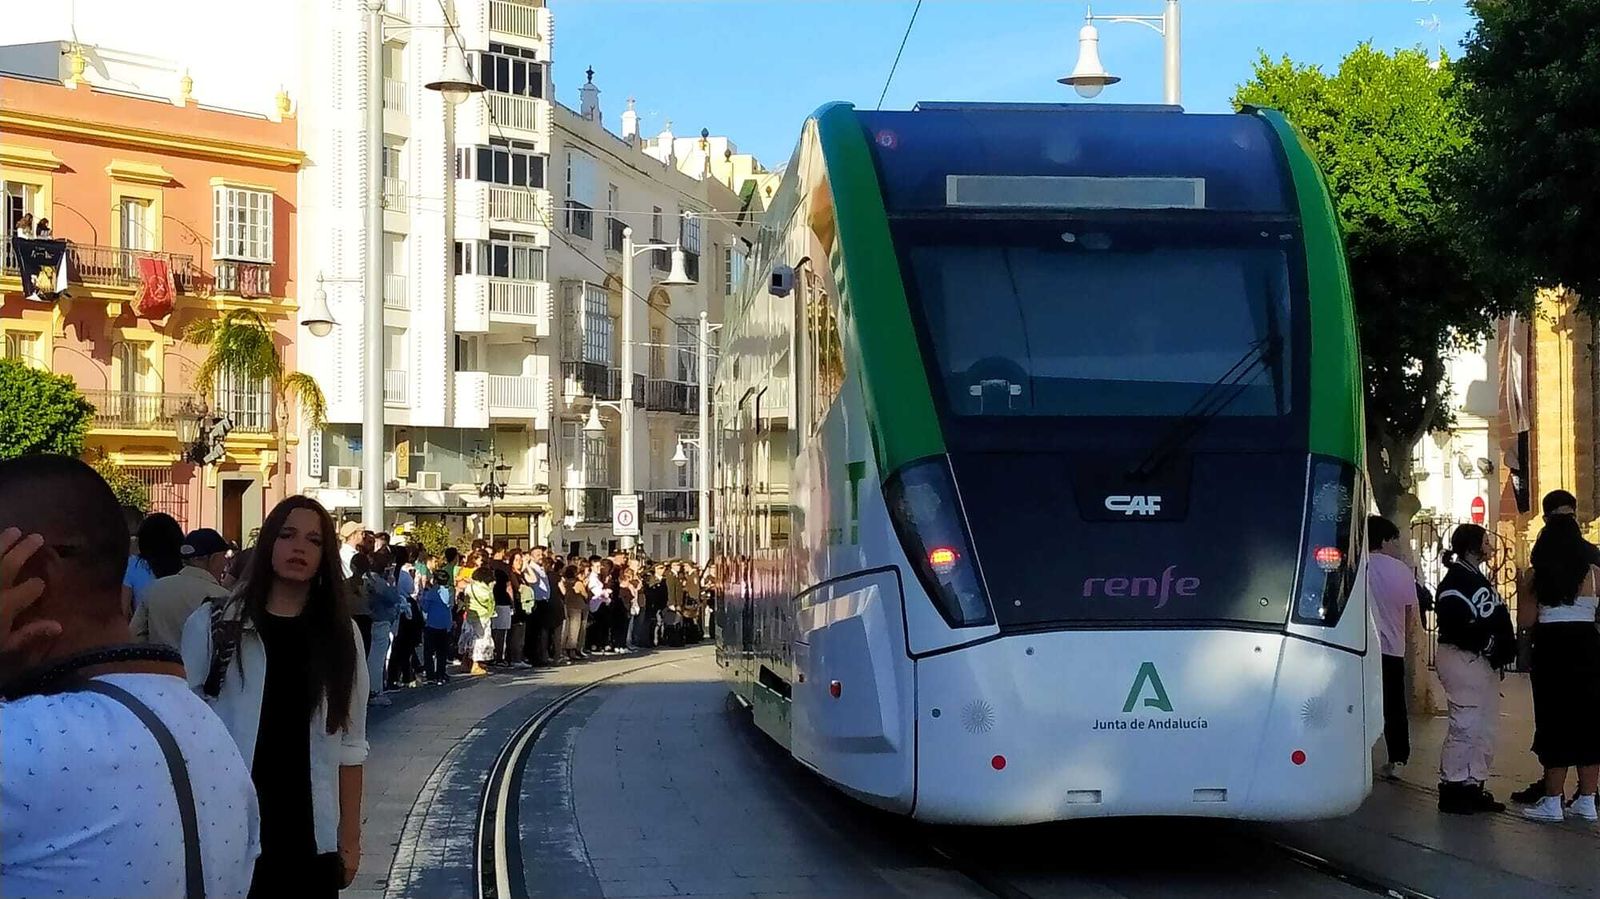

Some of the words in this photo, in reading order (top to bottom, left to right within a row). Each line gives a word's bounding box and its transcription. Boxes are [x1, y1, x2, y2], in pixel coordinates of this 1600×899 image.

[1104, 495, 1162, 515] CAF
[1083, 565, 1200, 609] renfe
[1092, 719, 1127, 730] Junta
[1130, 718, 1145, 730] de
[1148, 717, 1208, 729] Andalucía
